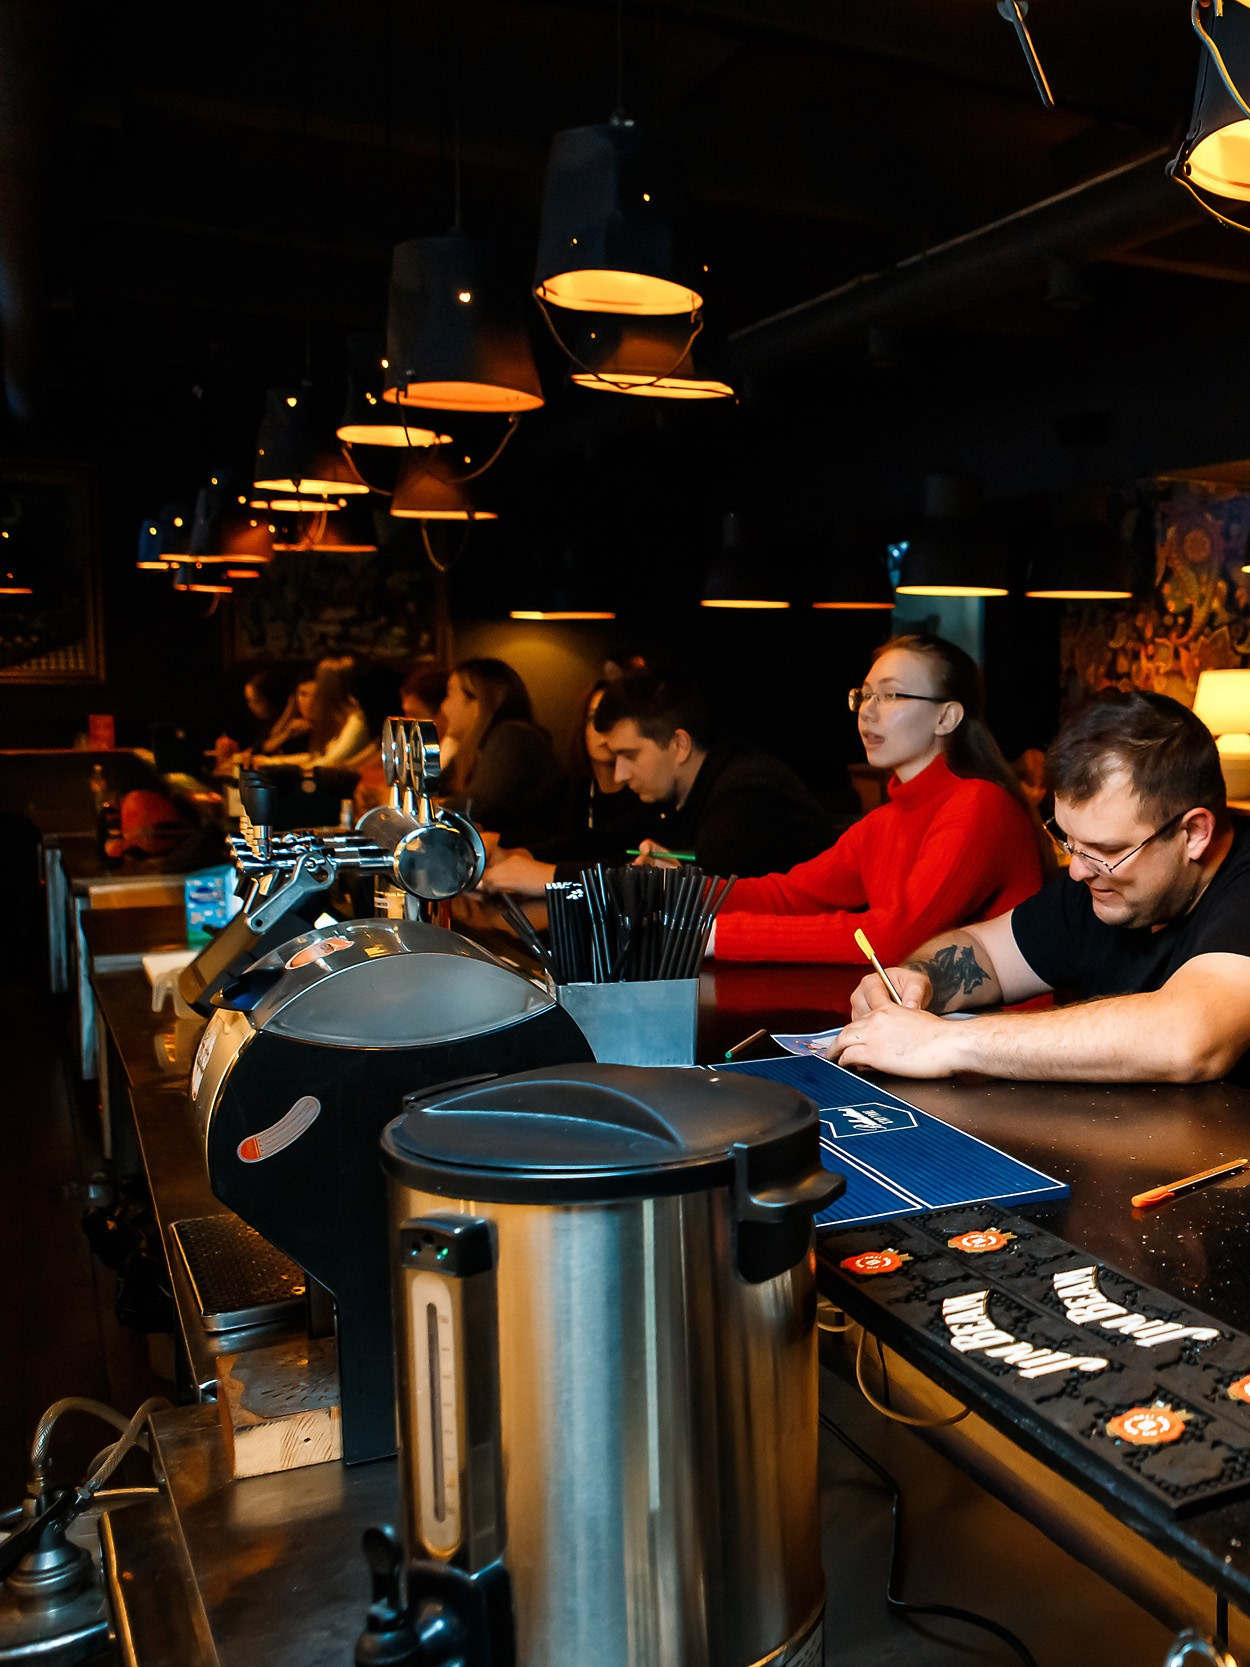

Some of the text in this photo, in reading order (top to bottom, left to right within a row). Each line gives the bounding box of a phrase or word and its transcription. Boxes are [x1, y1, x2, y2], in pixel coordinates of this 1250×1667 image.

[943, 1290, 1108, 1379] JIM BEAM
[1053, 1266, 1220, 1347] JIM BEAM
